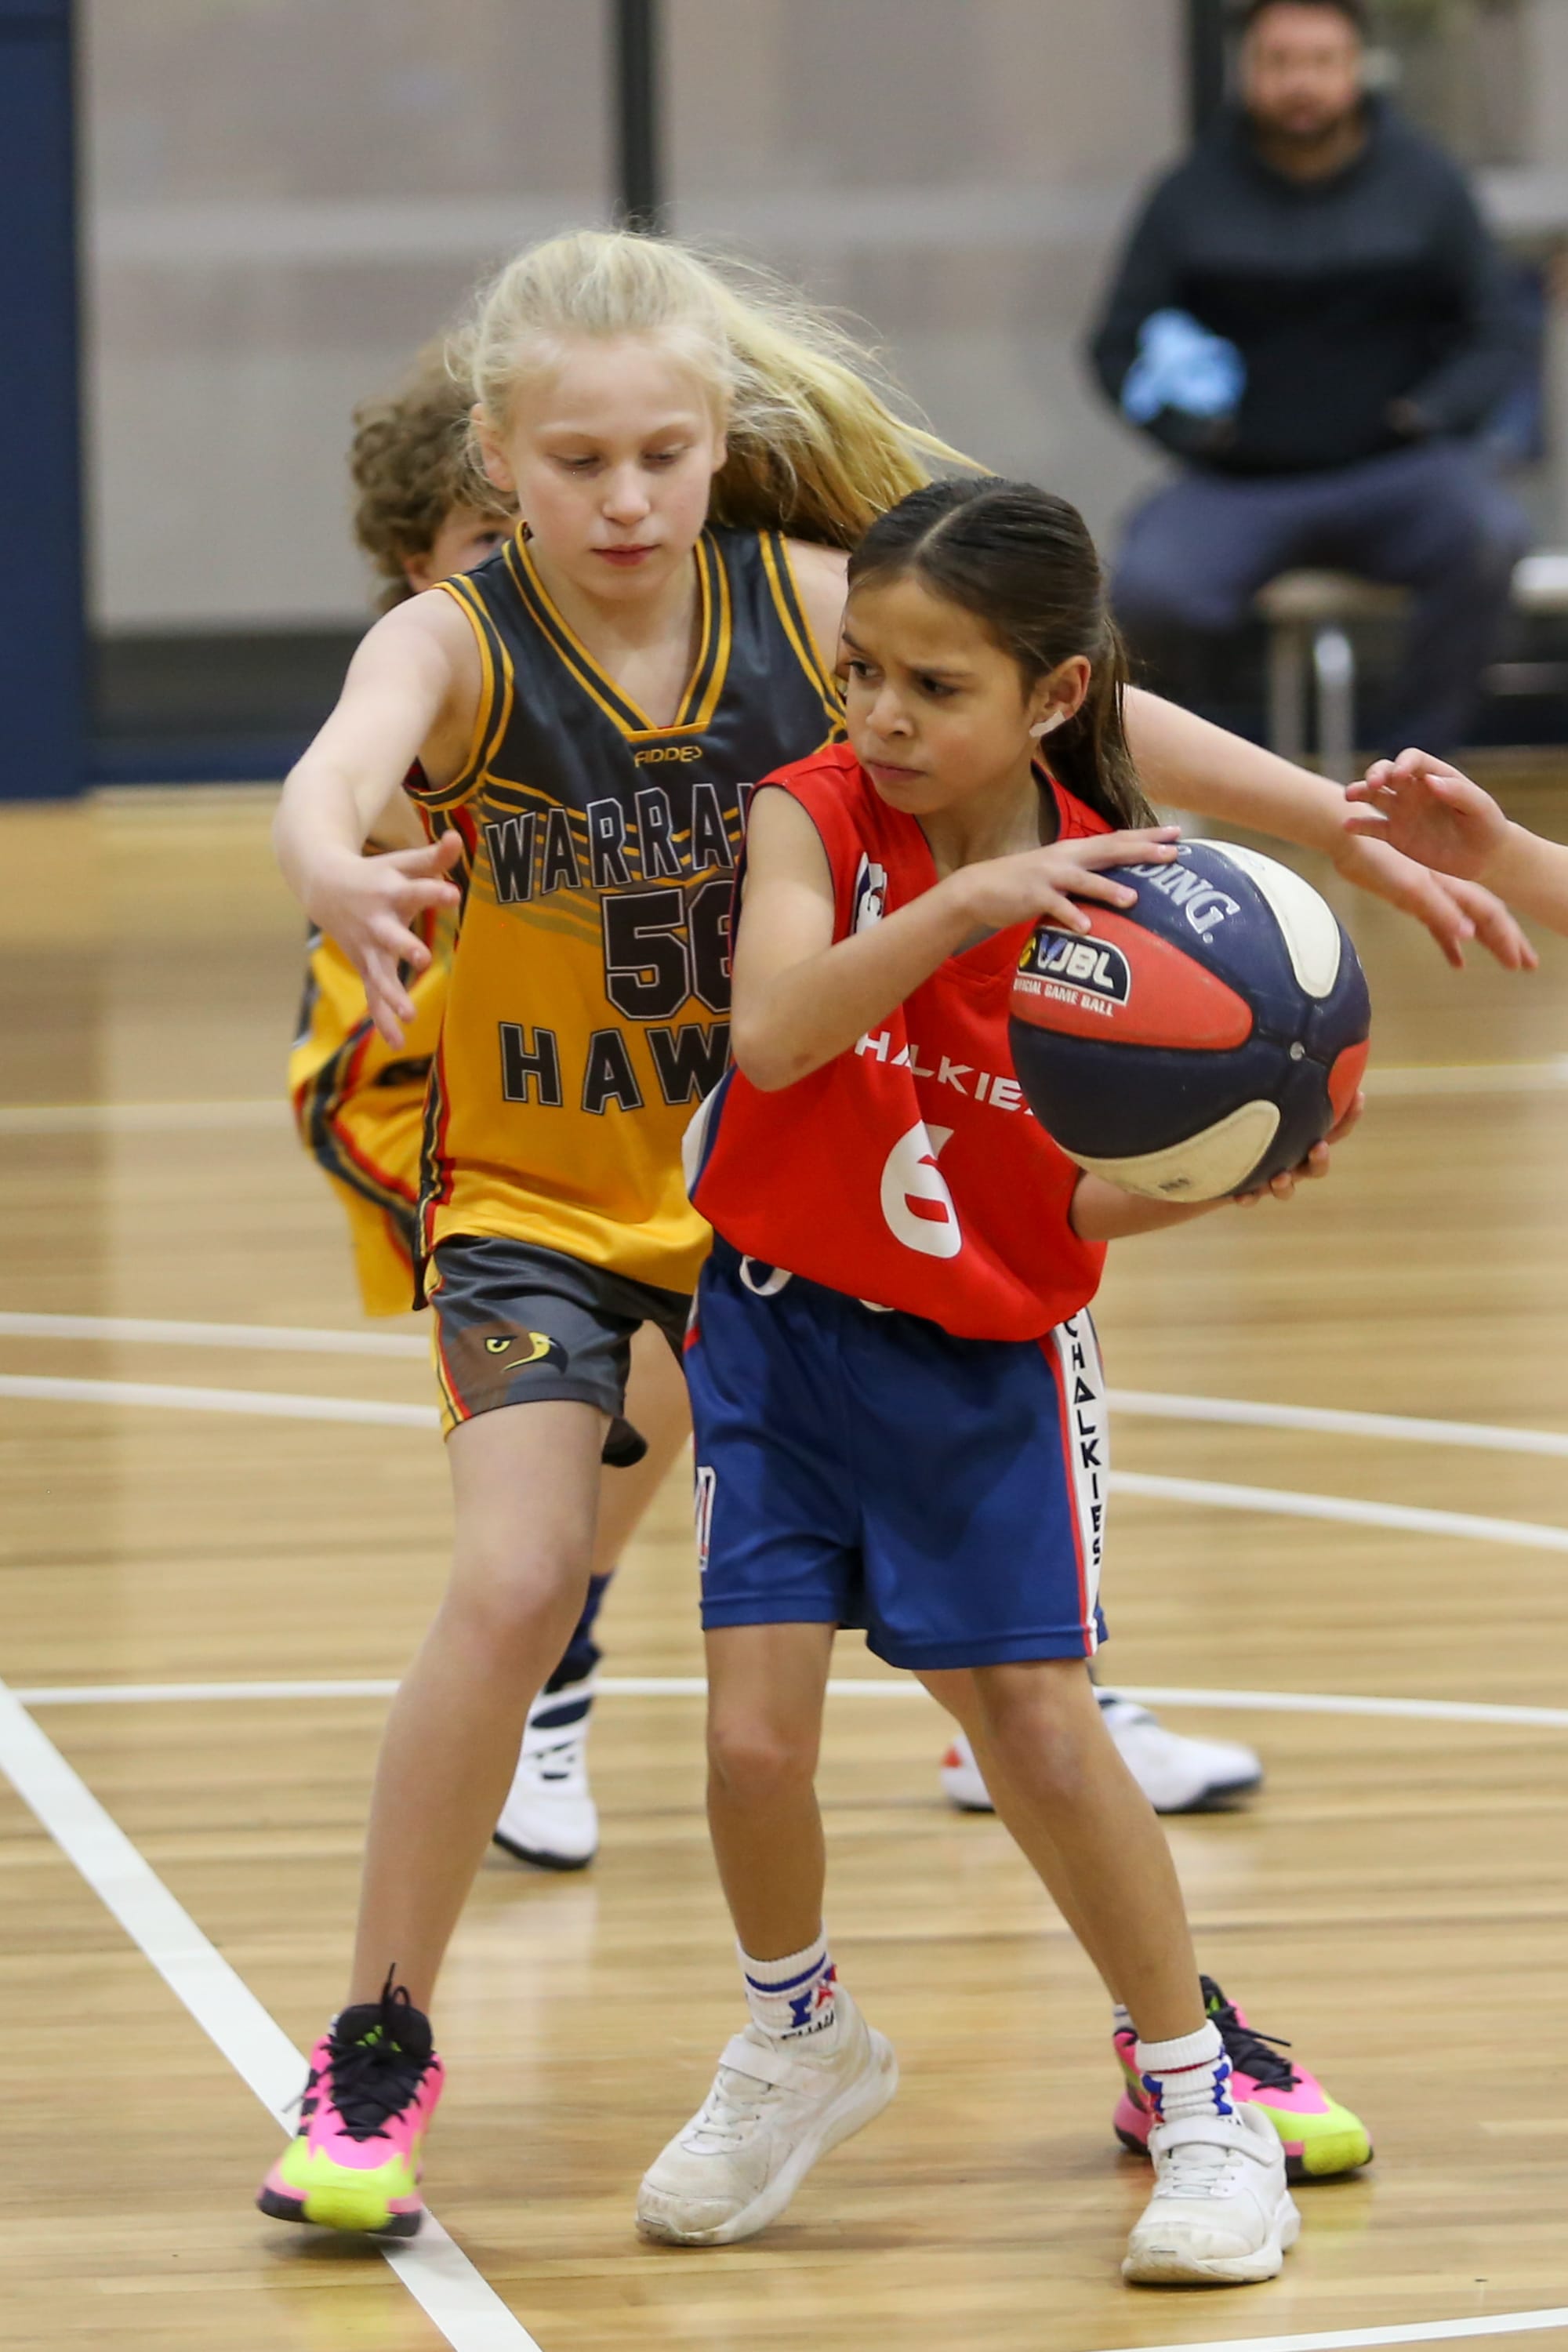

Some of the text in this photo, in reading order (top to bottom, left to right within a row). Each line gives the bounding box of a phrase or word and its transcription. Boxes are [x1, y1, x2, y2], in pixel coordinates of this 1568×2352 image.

[1044, 983, 1080, 1006] GAME
[1080, 994, 1114, 1017] BALL
[854, 1030, 1034, 1116] HALKIE
[880, 1119, 963, 1259] 6
